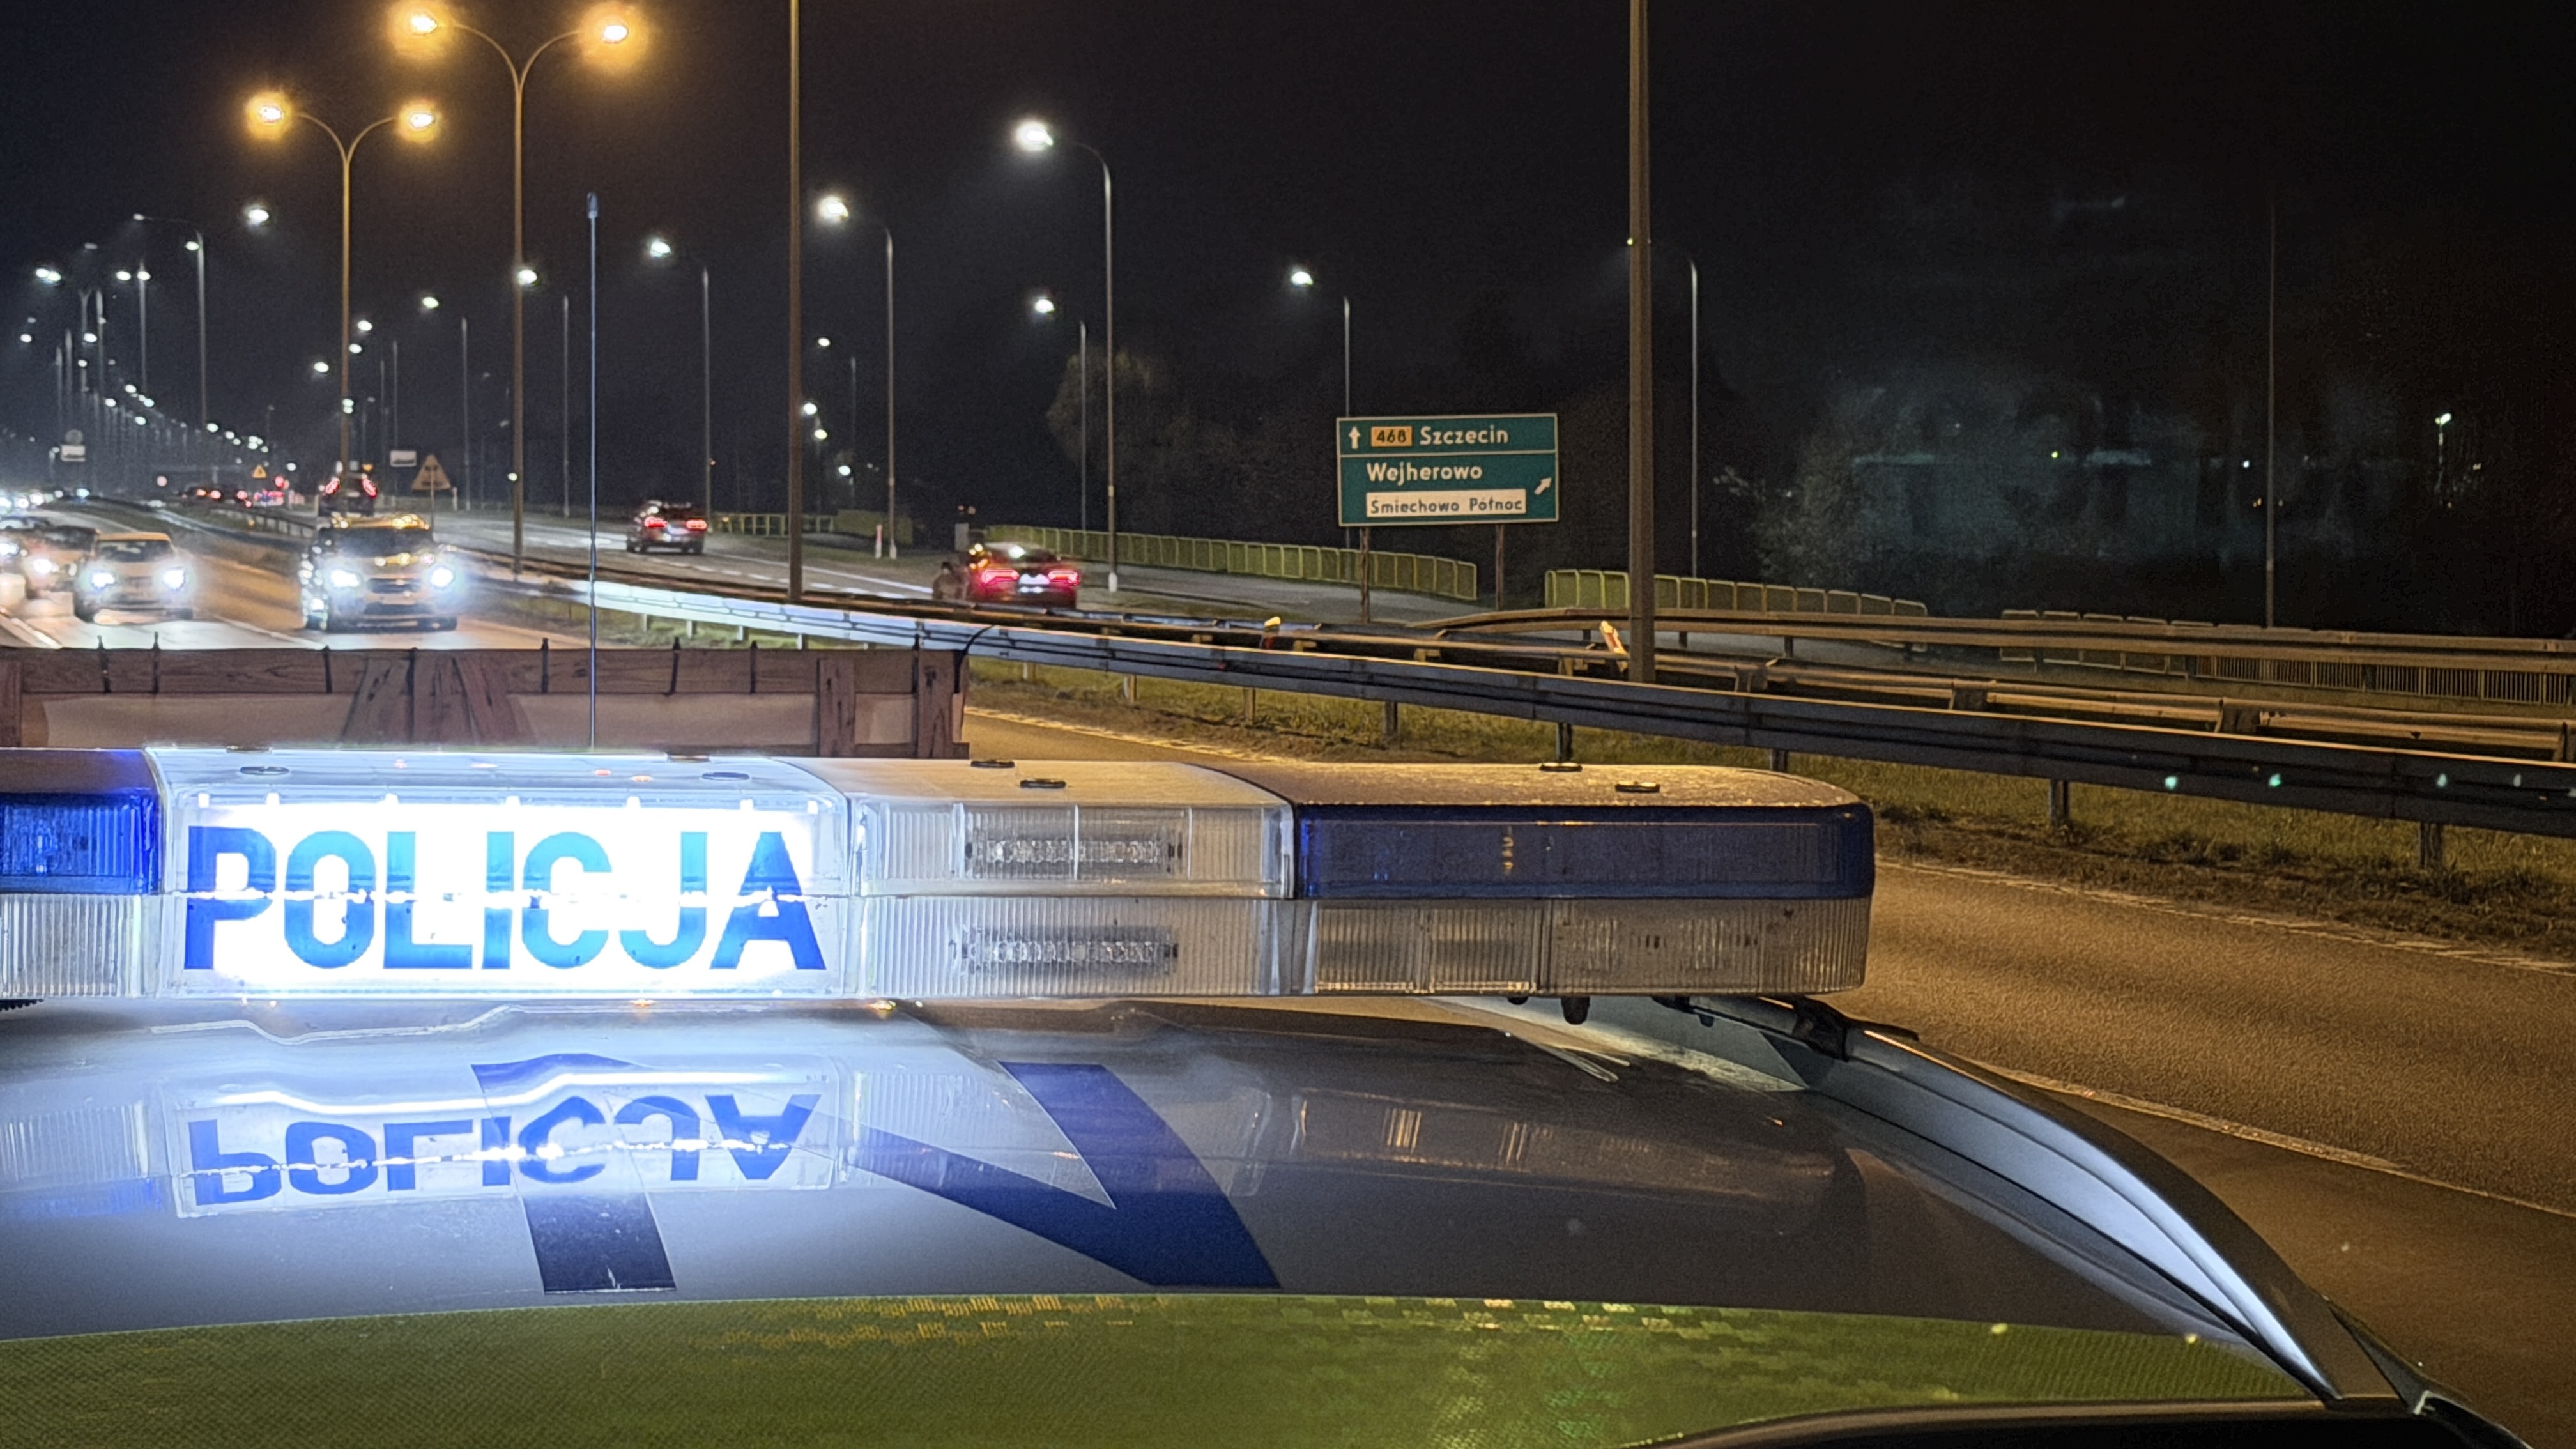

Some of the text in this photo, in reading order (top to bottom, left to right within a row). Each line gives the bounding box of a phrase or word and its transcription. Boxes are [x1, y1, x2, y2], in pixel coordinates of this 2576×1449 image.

[1376, 424, 1509, 445] 468 Szczecin
[1366, 461, 1483, 486] Wejherowo
[183, 825, 827, 970] POLICJA
